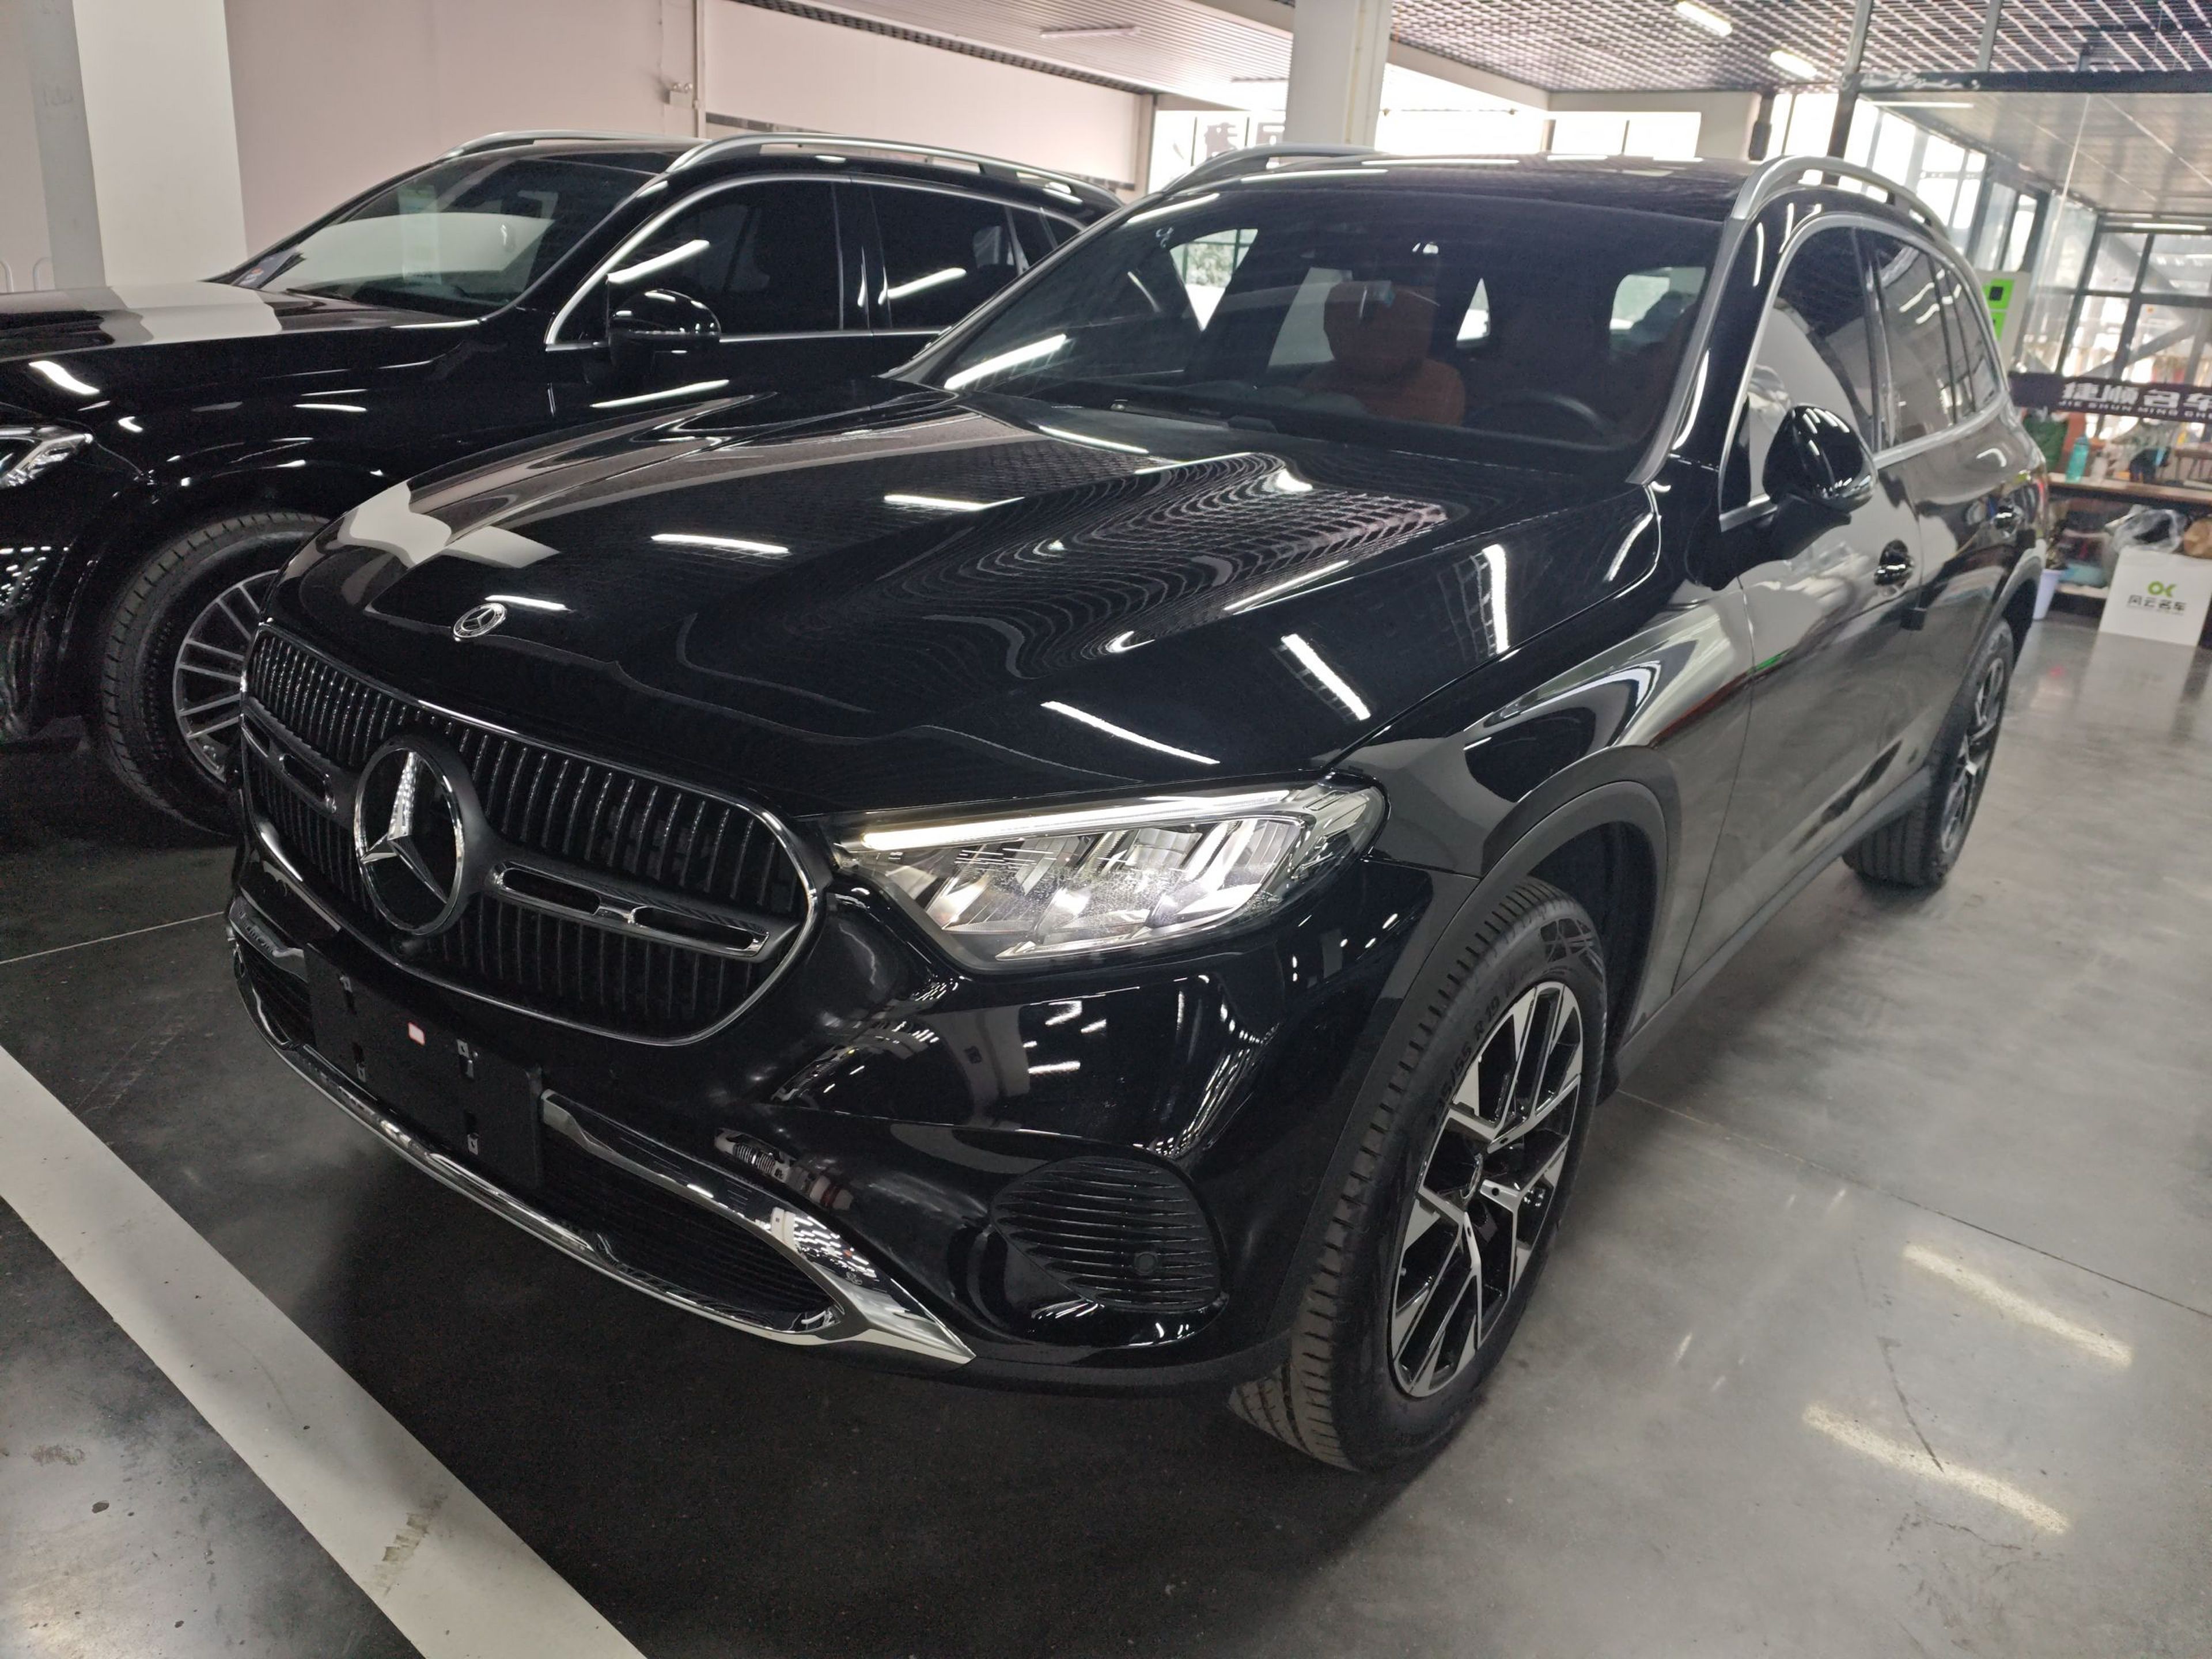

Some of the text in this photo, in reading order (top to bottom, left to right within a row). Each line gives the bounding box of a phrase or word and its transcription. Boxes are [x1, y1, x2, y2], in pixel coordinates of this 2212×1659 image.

[2062, 381, 2212, 411] 捷顺名车
[2058, 400, 2082, 408] JIE
[2088, 402, 2133, 412] SHUN
[2138, 406, 2179, 416] MING
